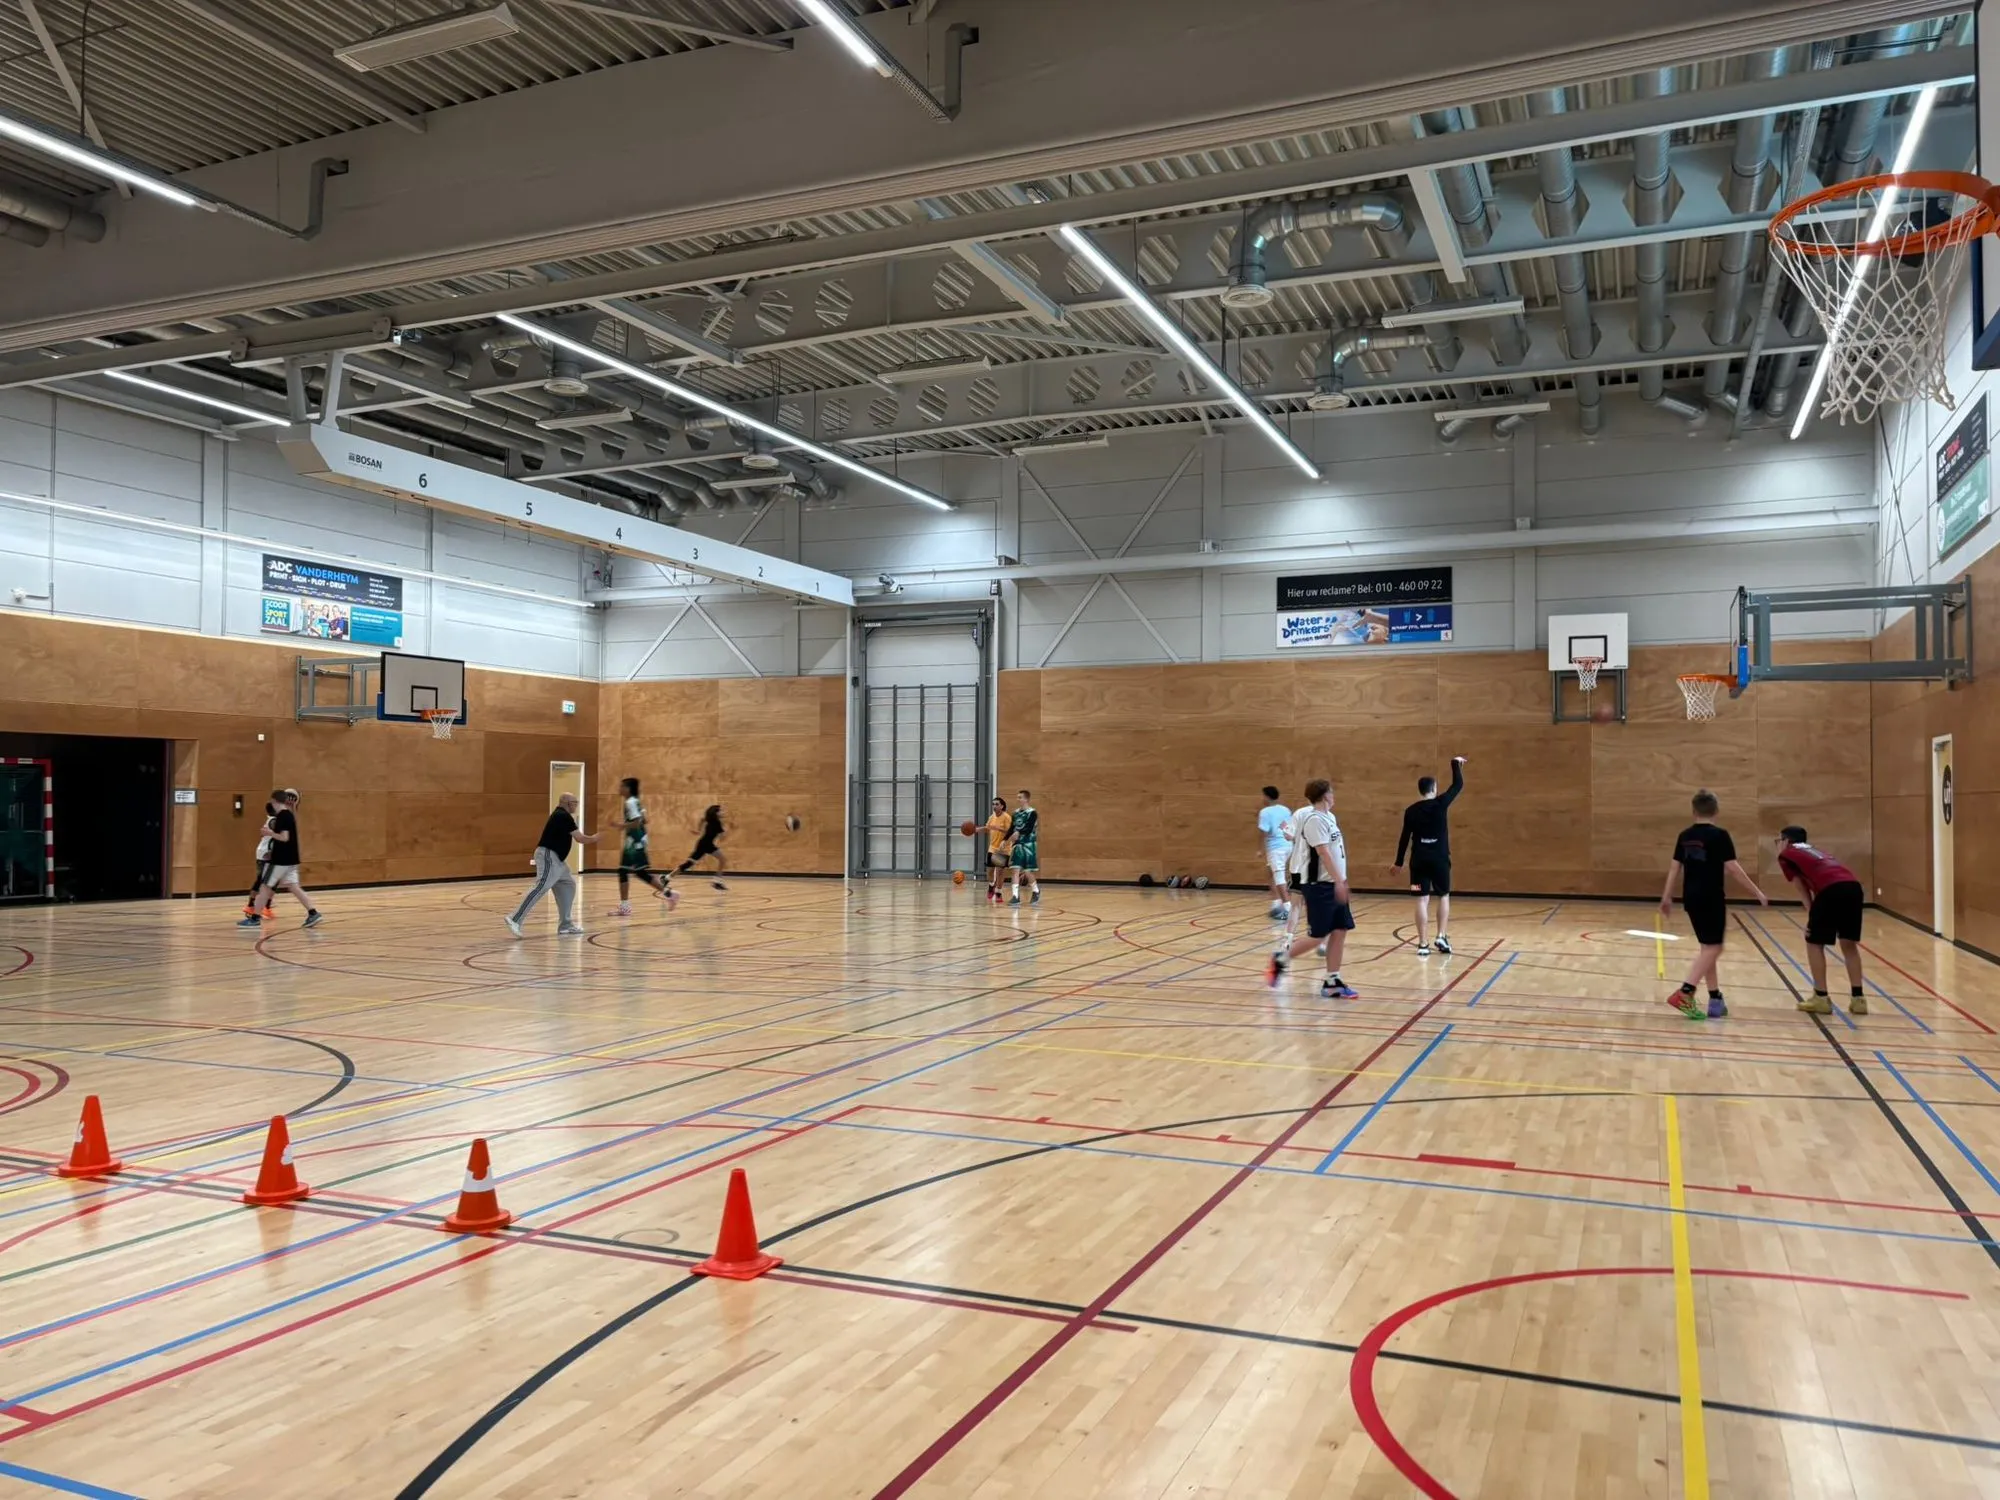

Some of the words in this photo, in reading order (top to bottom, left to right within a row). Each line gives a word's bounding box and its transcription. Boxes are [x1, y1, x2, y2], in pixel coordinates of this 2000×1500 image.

[356, 454, 382, 470] BOSAN
[418, 473, 428, 488] 6
[525, 502, 533, 516] 5
[615, 528, 622, 540] 4
[693, 548, 699, 560] 3
[758, 566, 764, 577] 2
[816, 582, 820, 592] 1
[268, 560, 292, 573] ADC
[295, 564, 359, 584] VANDERHEYM
[269, 571, 288, 580] PRINT
[292, 575, 307, 583] SIGN
[330, 582, 346, 590] DRUK
[1287, 589, 1304, 598] Hier
[1320, 585, 1356, 596] reclame?
[1358, 584, 1373, 594] Bel:
[1376, 582, 1393, 592] 010
[1399, 581, 1416, 591] 460
[1418, 580, 1430, 590] 09
[1431, 580, 1443, 590] 22
[265, 600, 288, 610] SCOOR
[266, 608, 288, 618] SPORT
[265, 616, 287, 626] ZAAL
[1287, 616, 1323, 628] Water
